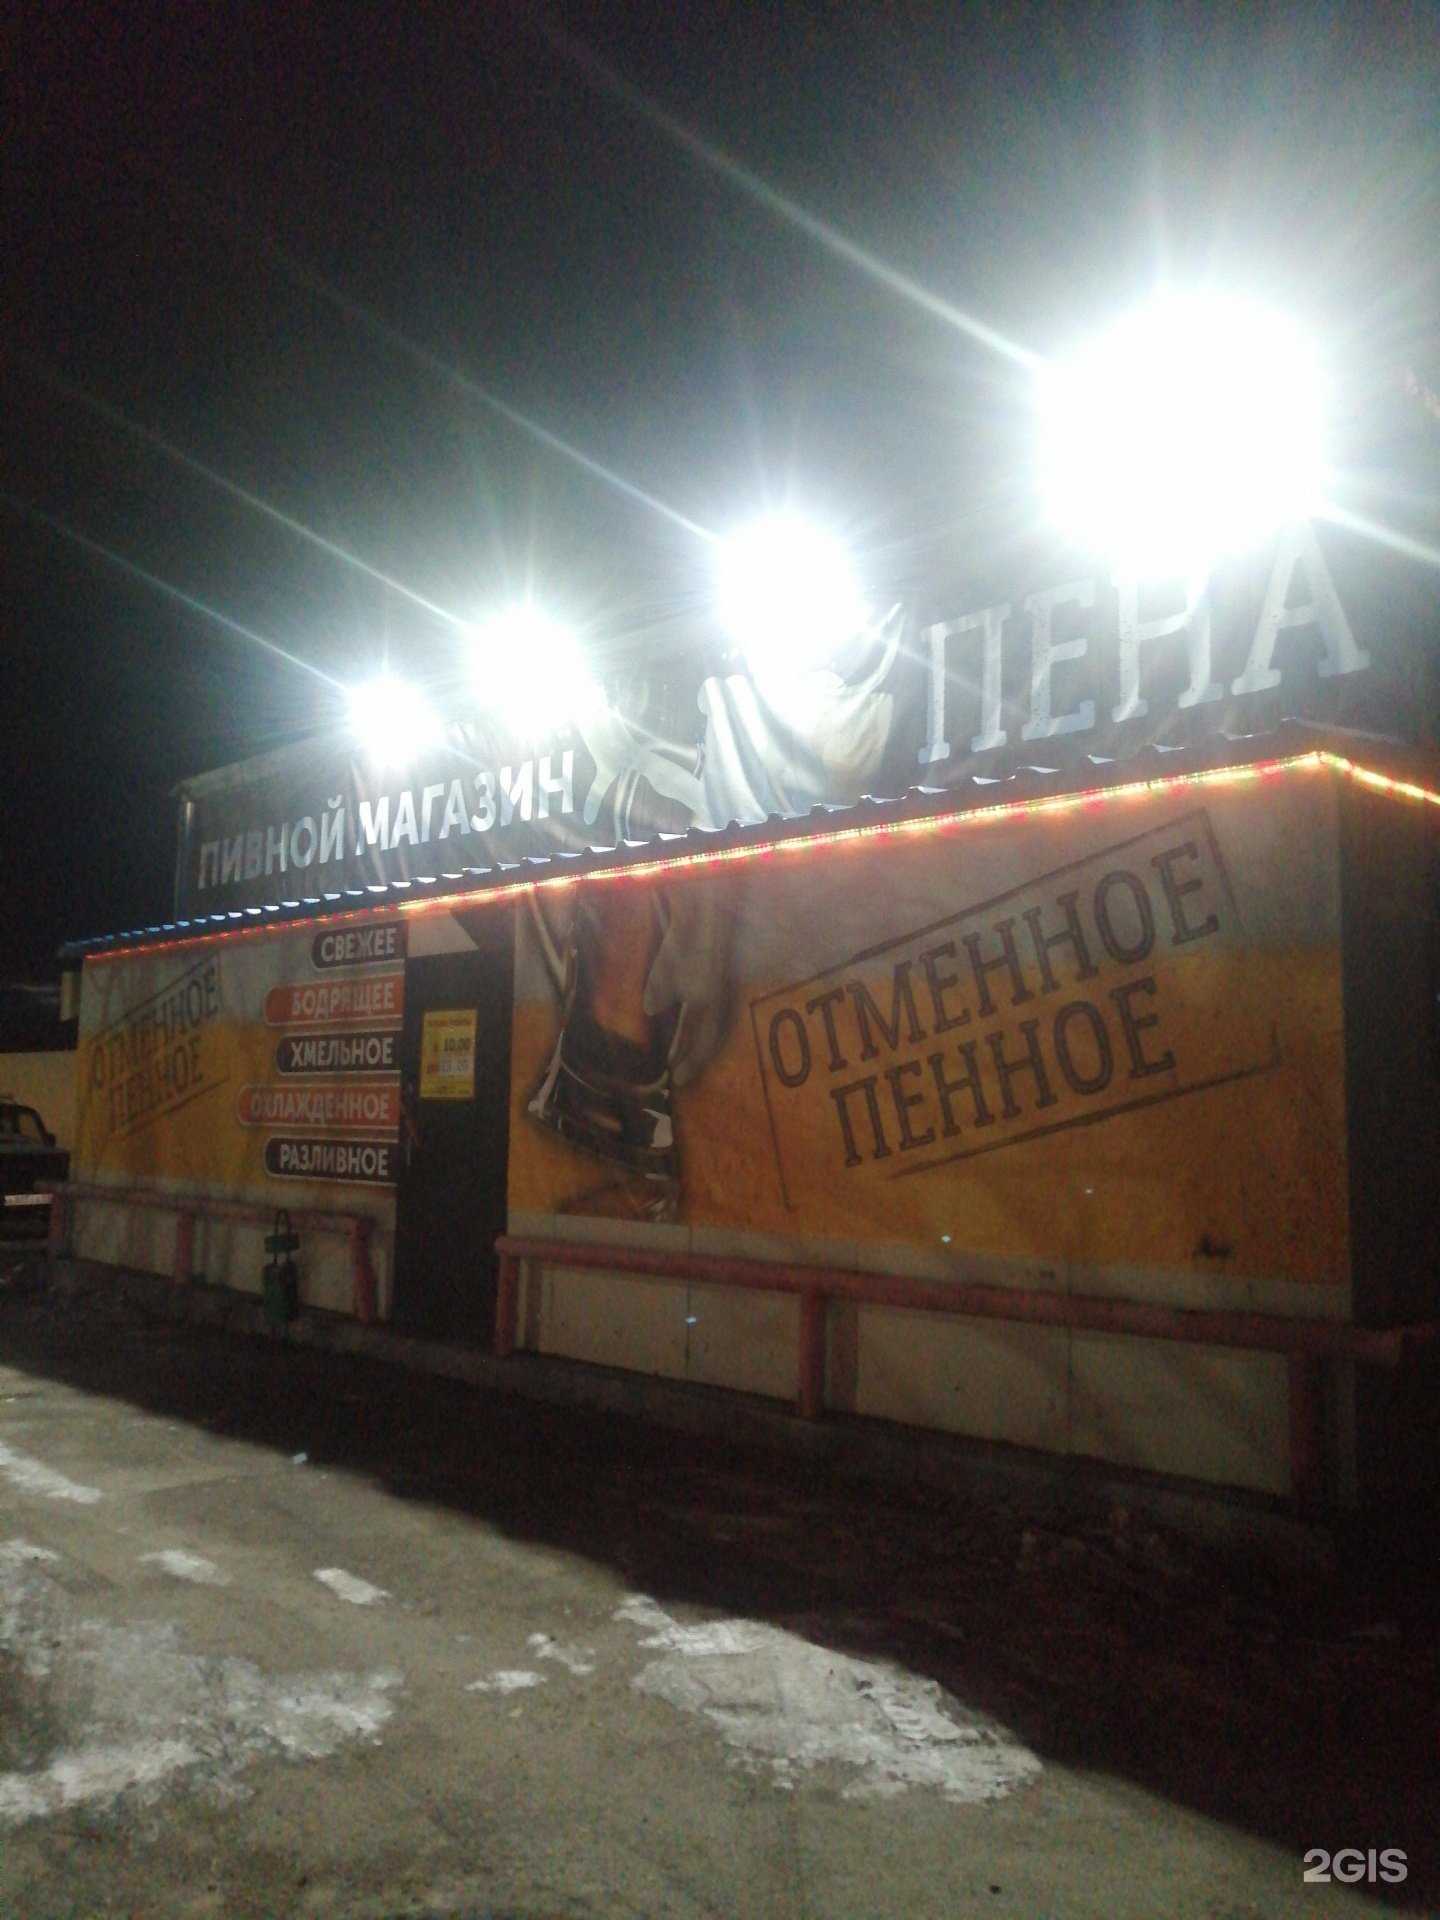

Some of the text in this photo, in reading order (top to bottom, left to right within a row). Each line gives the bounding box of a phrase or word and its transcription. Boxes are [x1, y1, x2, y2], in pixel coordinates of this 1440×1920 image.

[917, 518, 1371, 764] ПЕНА
[198, 749, 575, 889] ПИВНОЙ МАГАЗИН
[321, 927, 397, 963] СВЕЖЕЕ
[768, 841, 1219, 1088] ОТМЕННОЕ
[291, 982, 395, 1019] БОДРЯЩЕЕ
[290, 1037, 394, 1067] ХМЕЛЬНОЕ
[829, 976, 1176, 1168] ПЕННОЕ
[250, 1091, 390, 1126] ОХЛАЖДЕННОЕ
[279, 1143, 388, 1177] РАЗЛИВНОЕ
